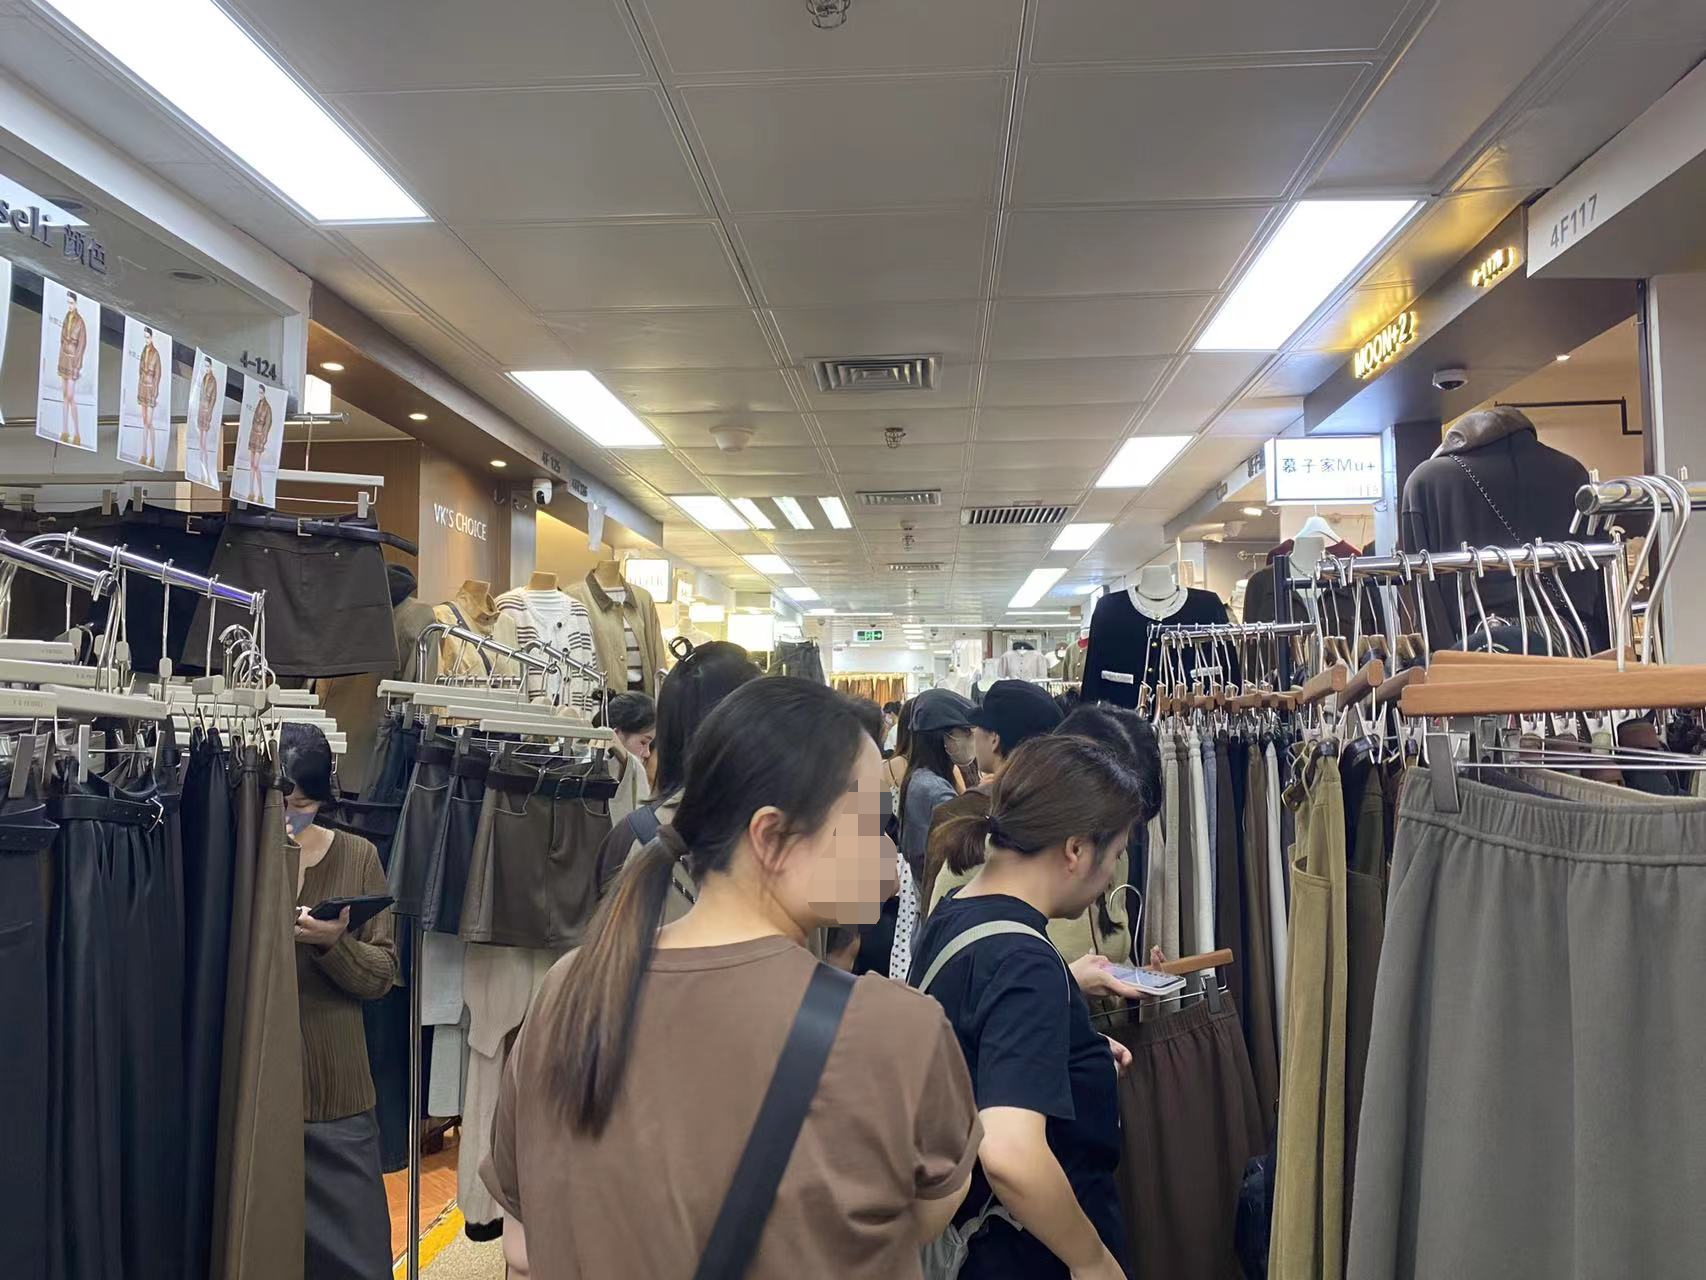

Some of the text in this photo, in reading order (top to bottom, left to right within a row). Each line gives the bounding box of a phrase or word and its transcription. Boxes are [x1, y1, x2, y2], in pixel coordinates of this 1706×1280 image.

[1550, 193, 1598, 248] 4F117
[240, 350, 277, 381] 4-124
[433, 502, 487, 541] VK'S CHOICE
